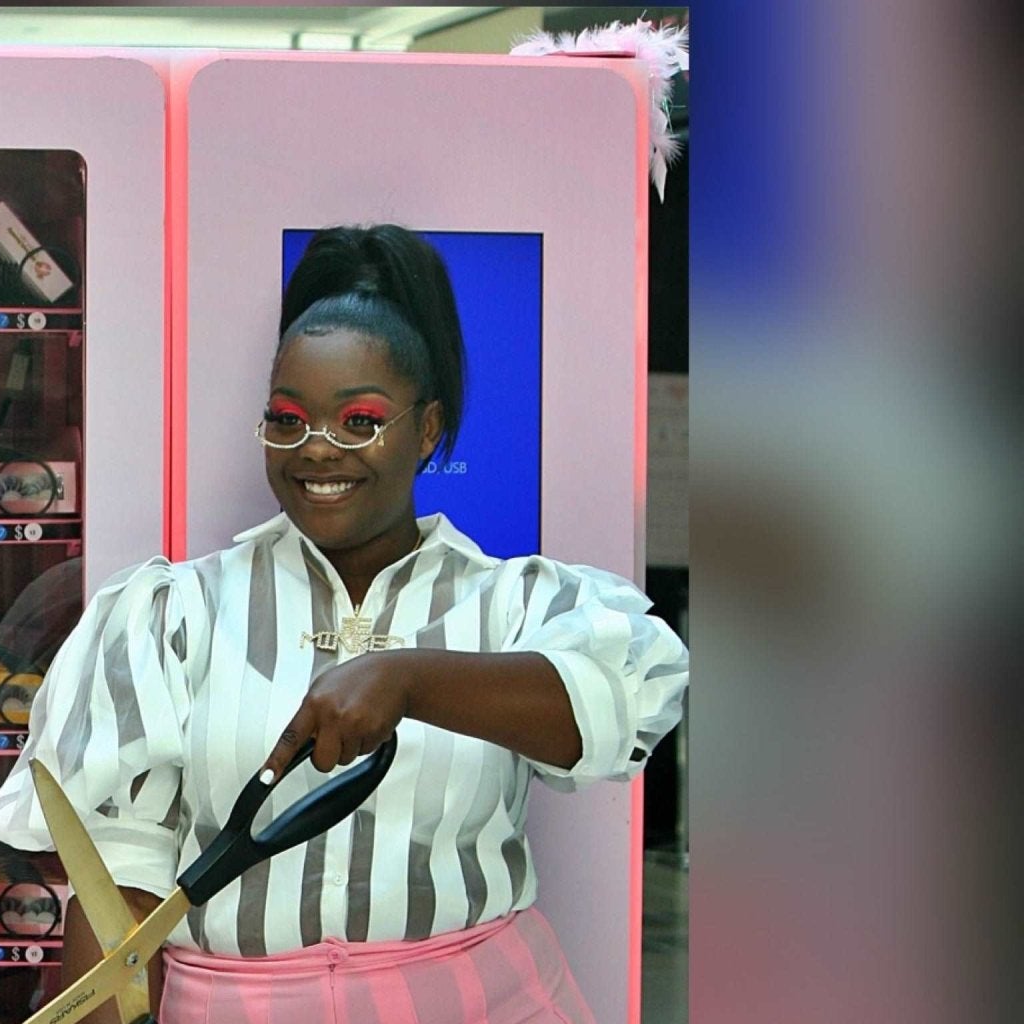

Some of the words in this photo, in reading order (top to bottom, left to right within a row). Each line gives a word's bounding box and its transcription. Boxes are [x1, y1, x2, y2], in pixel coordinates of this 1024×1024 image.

[17, 314, 25, 328] $
[443, 461, 468, 474] USB
[15, 526, 23, 540] $
[16, 735, 25, 749] $
[12, 946, 20, 961] $
